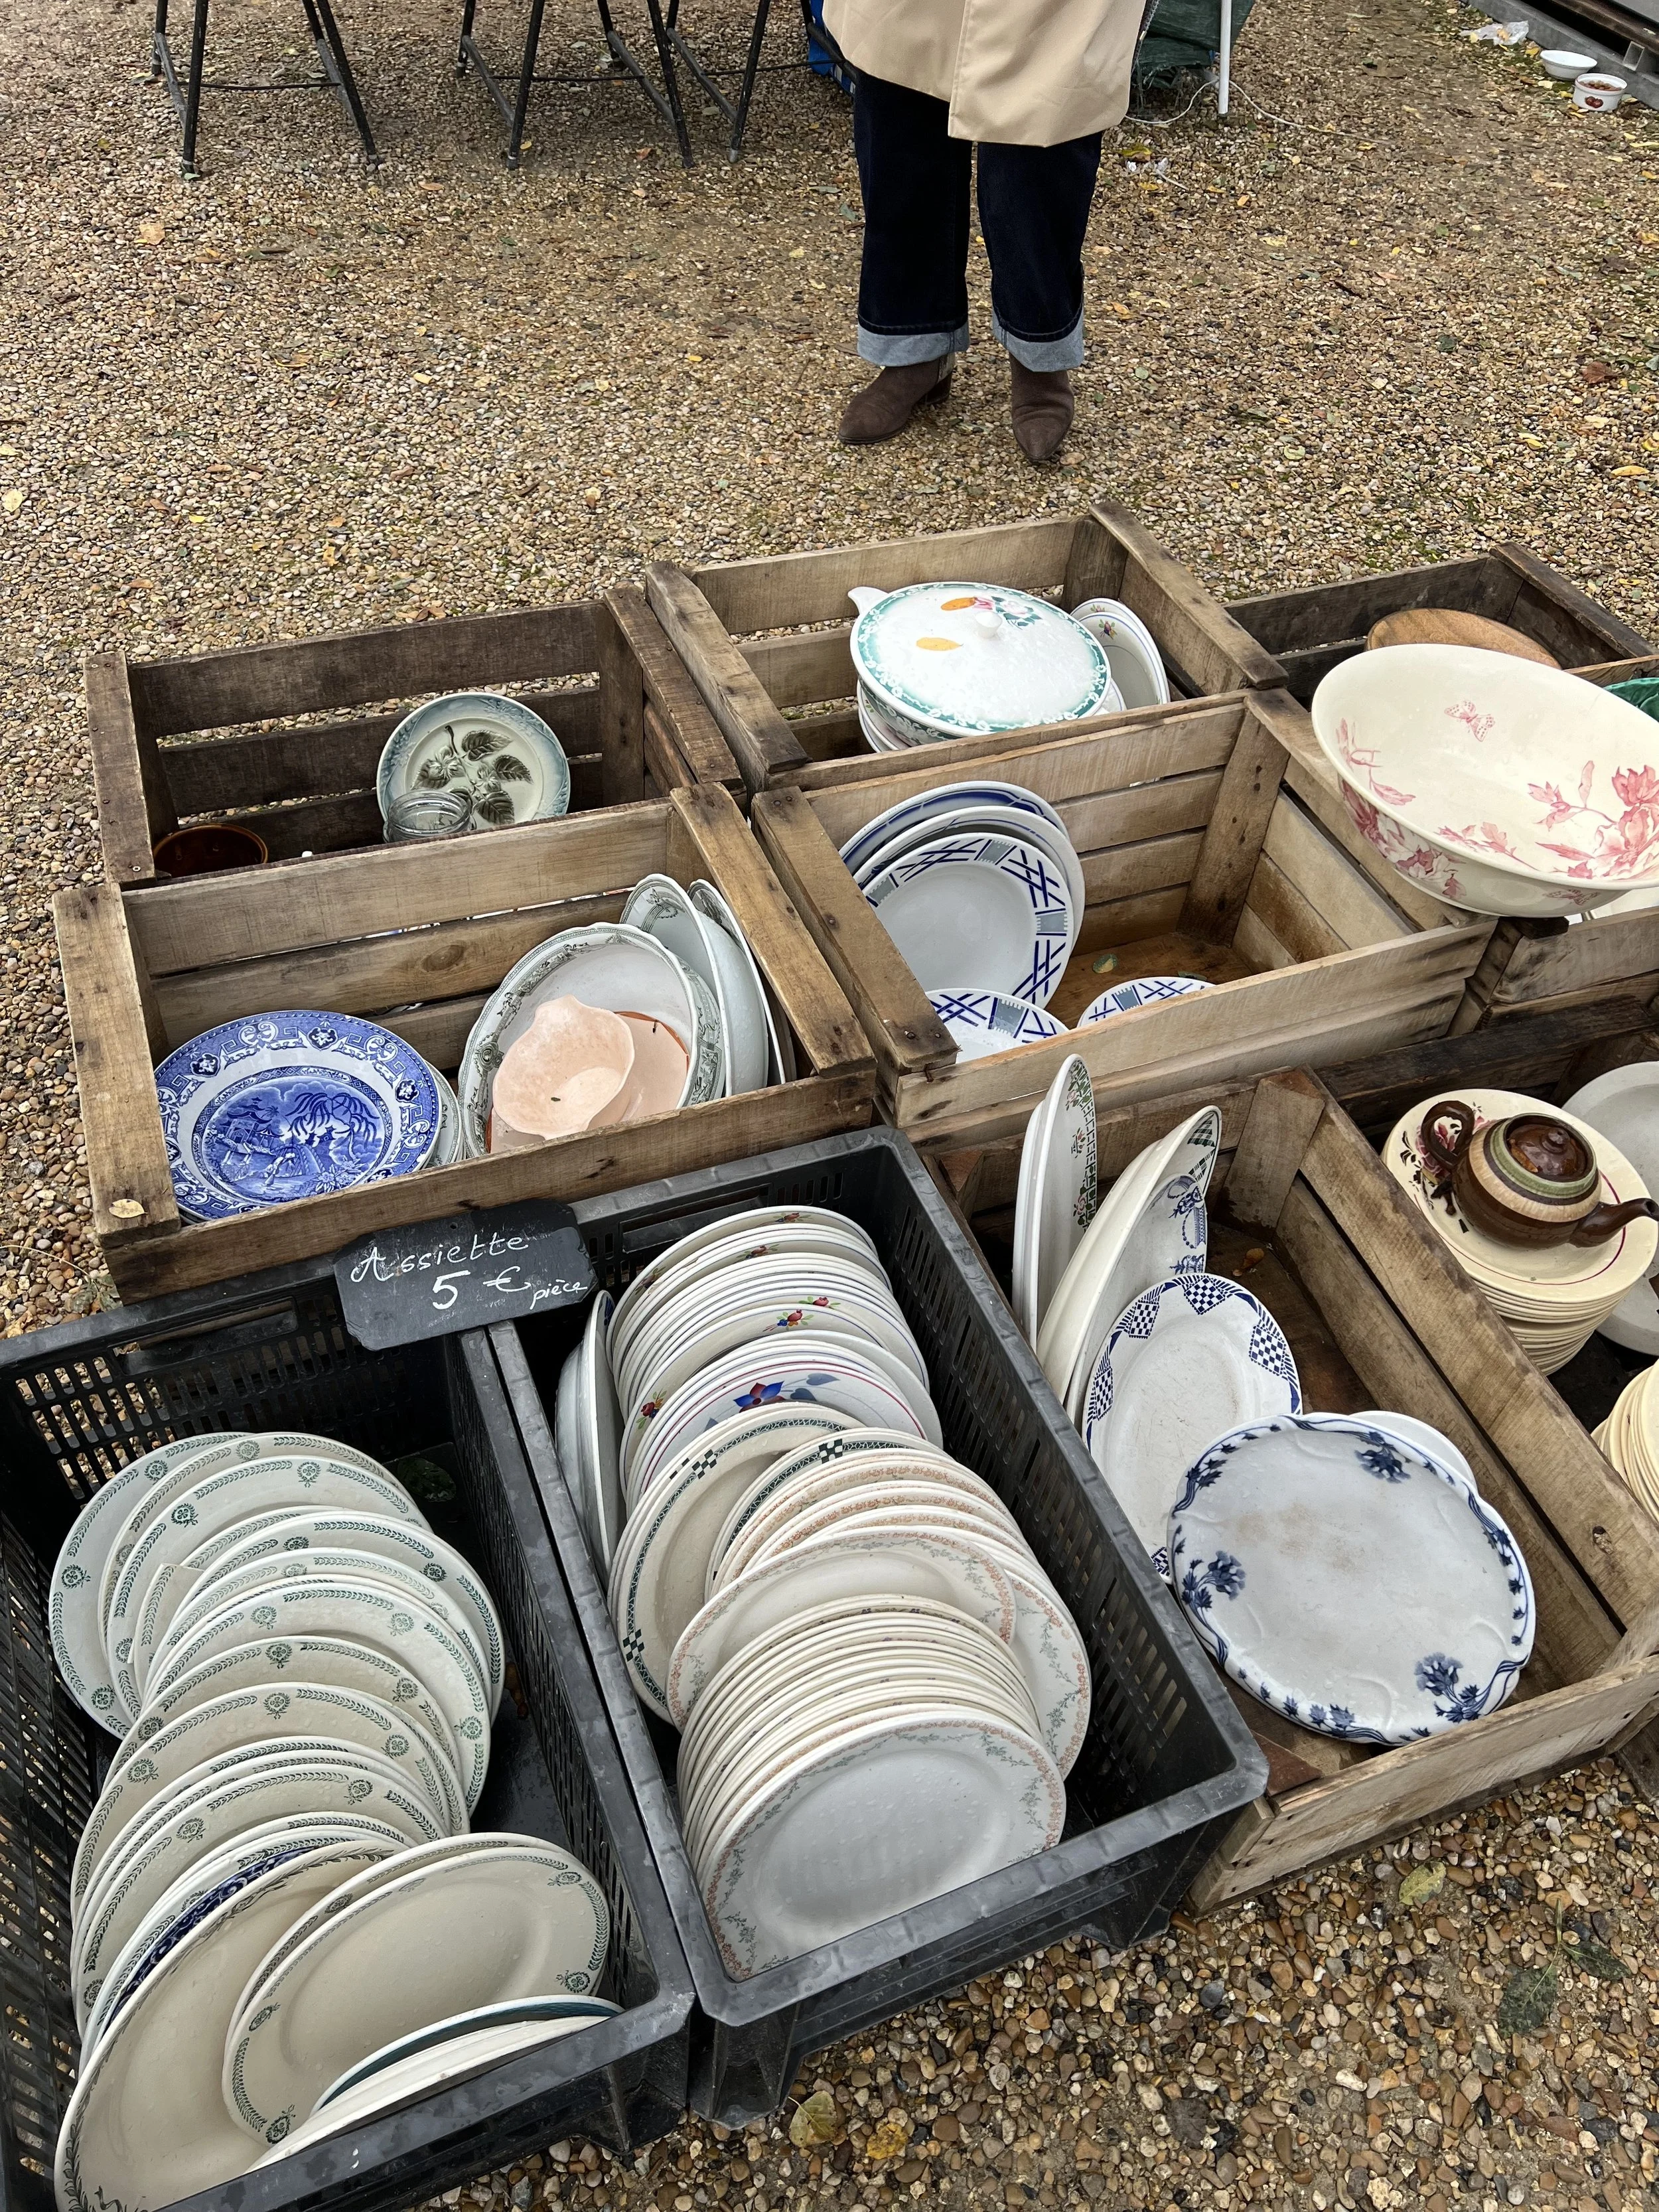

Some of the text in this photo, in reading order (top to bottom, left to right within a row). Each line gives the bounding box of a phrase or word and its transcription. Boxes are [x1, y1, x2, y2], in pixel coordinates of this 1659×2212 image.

[350, 1232, 529, 1282] Assiette
[432, 1266, 589, 1311] 5 € pièce
